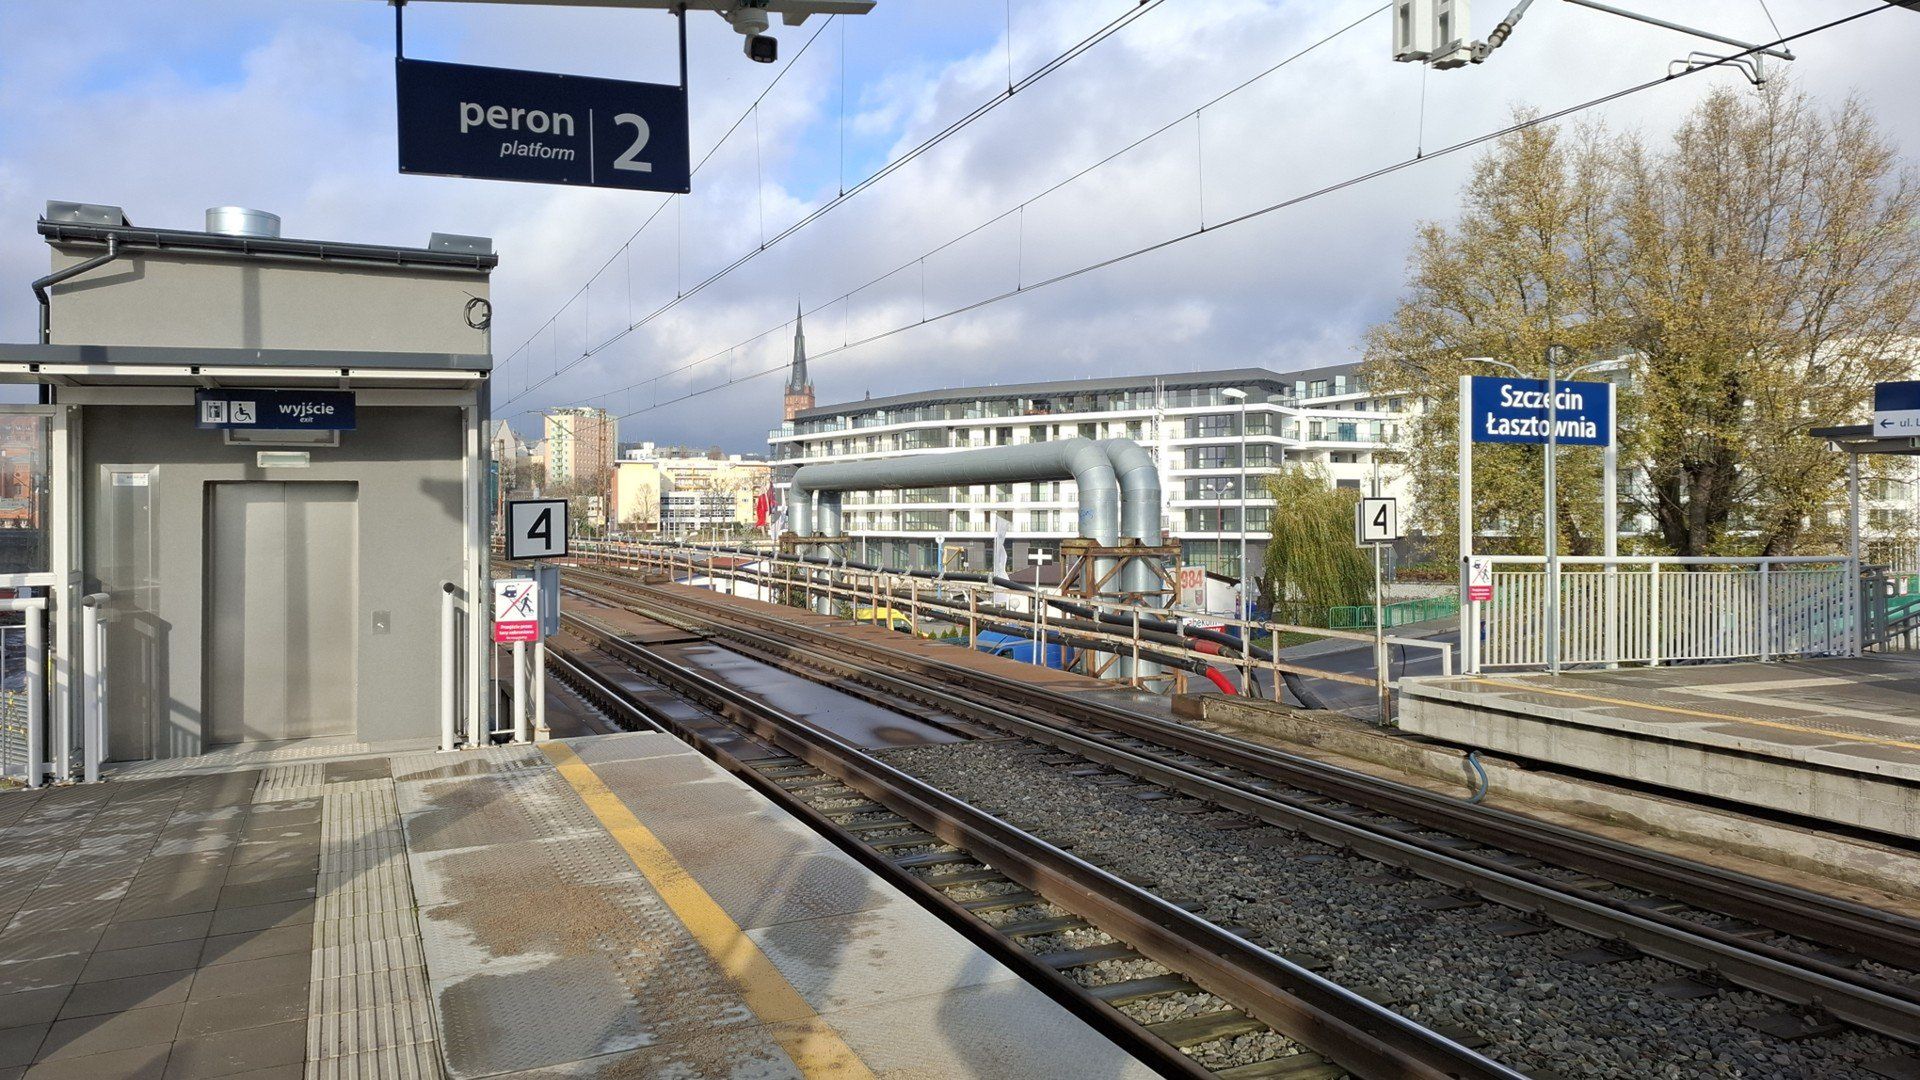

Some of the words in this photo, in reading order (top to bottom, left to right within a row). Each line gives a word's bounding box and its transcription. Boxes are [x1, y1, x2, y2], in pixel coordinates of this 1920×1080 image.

[459, 101, 575, 137] peron
[500, 140, 575, 161] platform
[613, 112, 653, 173] 2
[279, 402, 335, 417] wyjście
[1500, 384, 1583, 411] Szczecin
[1486, 411, 1597, 438] Łasztownia
[1900, 418, 1913, 427] ul.
[527, 507, 552, 550] 4
[1373, 503, 1387, 535] 4
